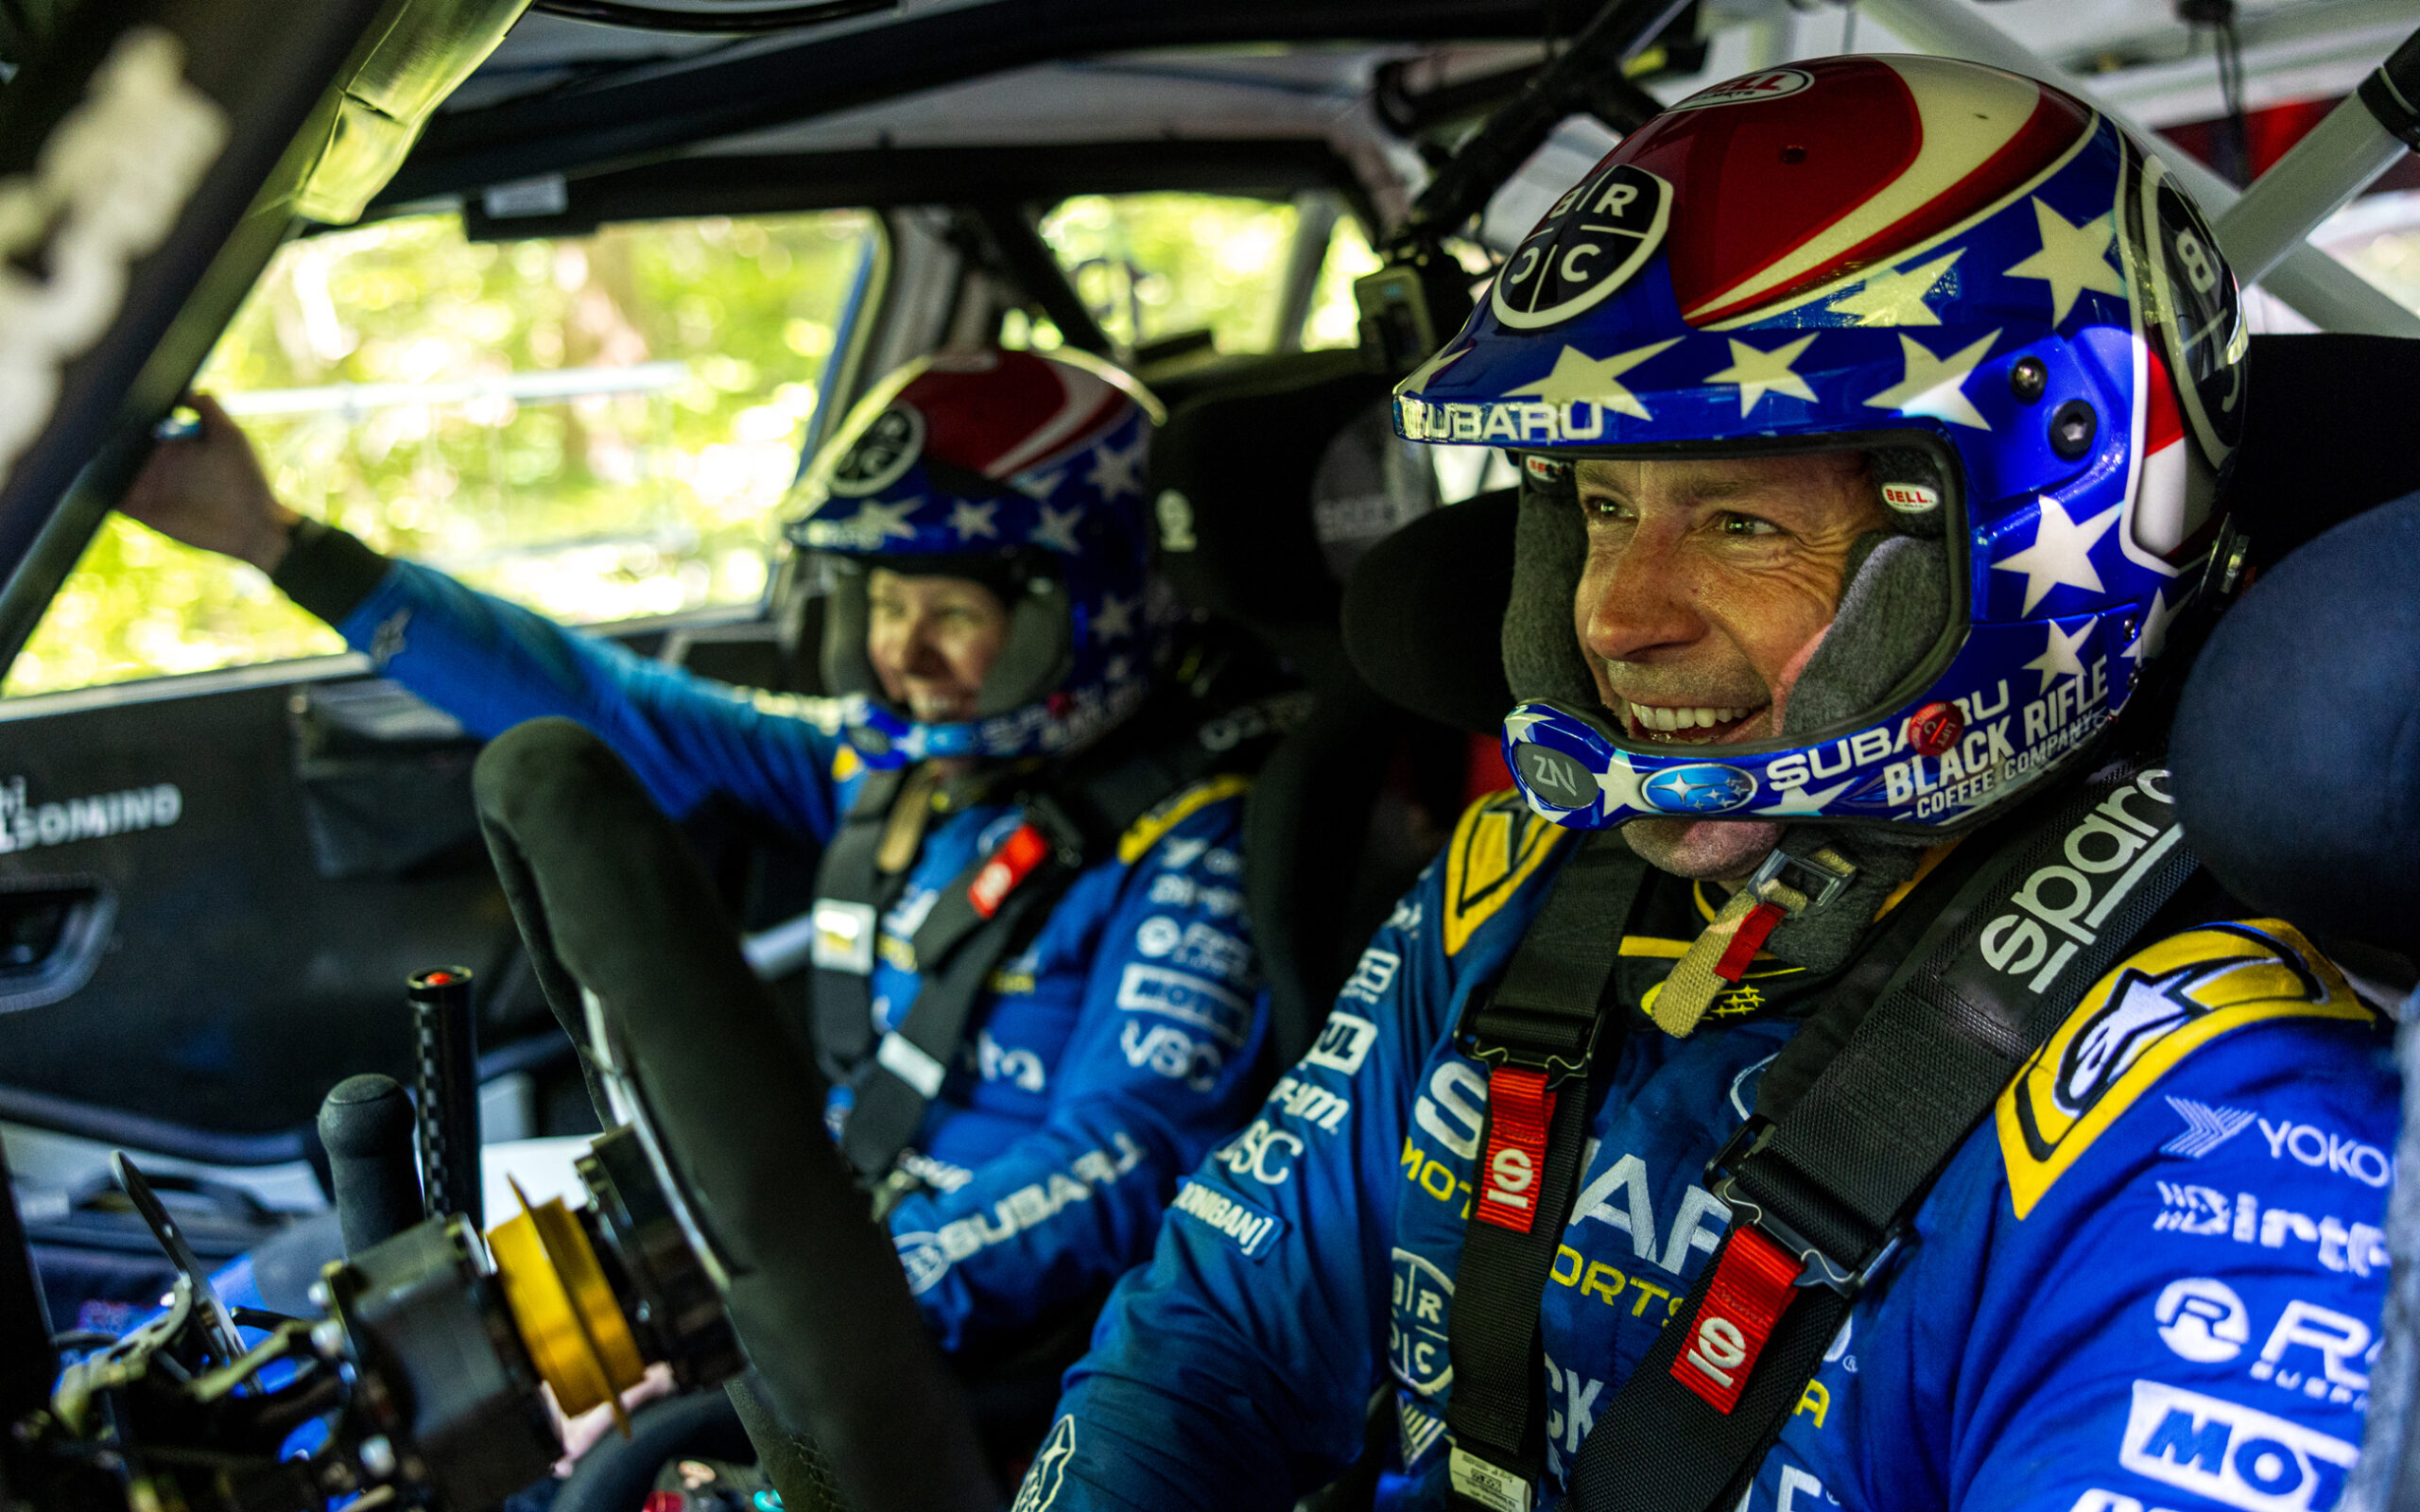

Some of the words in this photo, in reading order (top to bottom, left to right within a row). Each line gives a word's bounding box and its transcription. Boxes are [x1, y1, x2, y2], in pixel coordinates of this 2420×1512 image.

[1403, 401, 1603, 441] SUBARU
[1885, 489, 1928, 504] BELL
[1883, 714, 2015, 807] BLACK
[2023, 653, 2109, 747] RIFLE
[1916, 769, 1996, 819] COFFEE
[2003, 707, 2093, 782] COMPANY
[1979, 768, 2176, 977] sparc
[2257, 1117, 2398, 1189] YOKO
